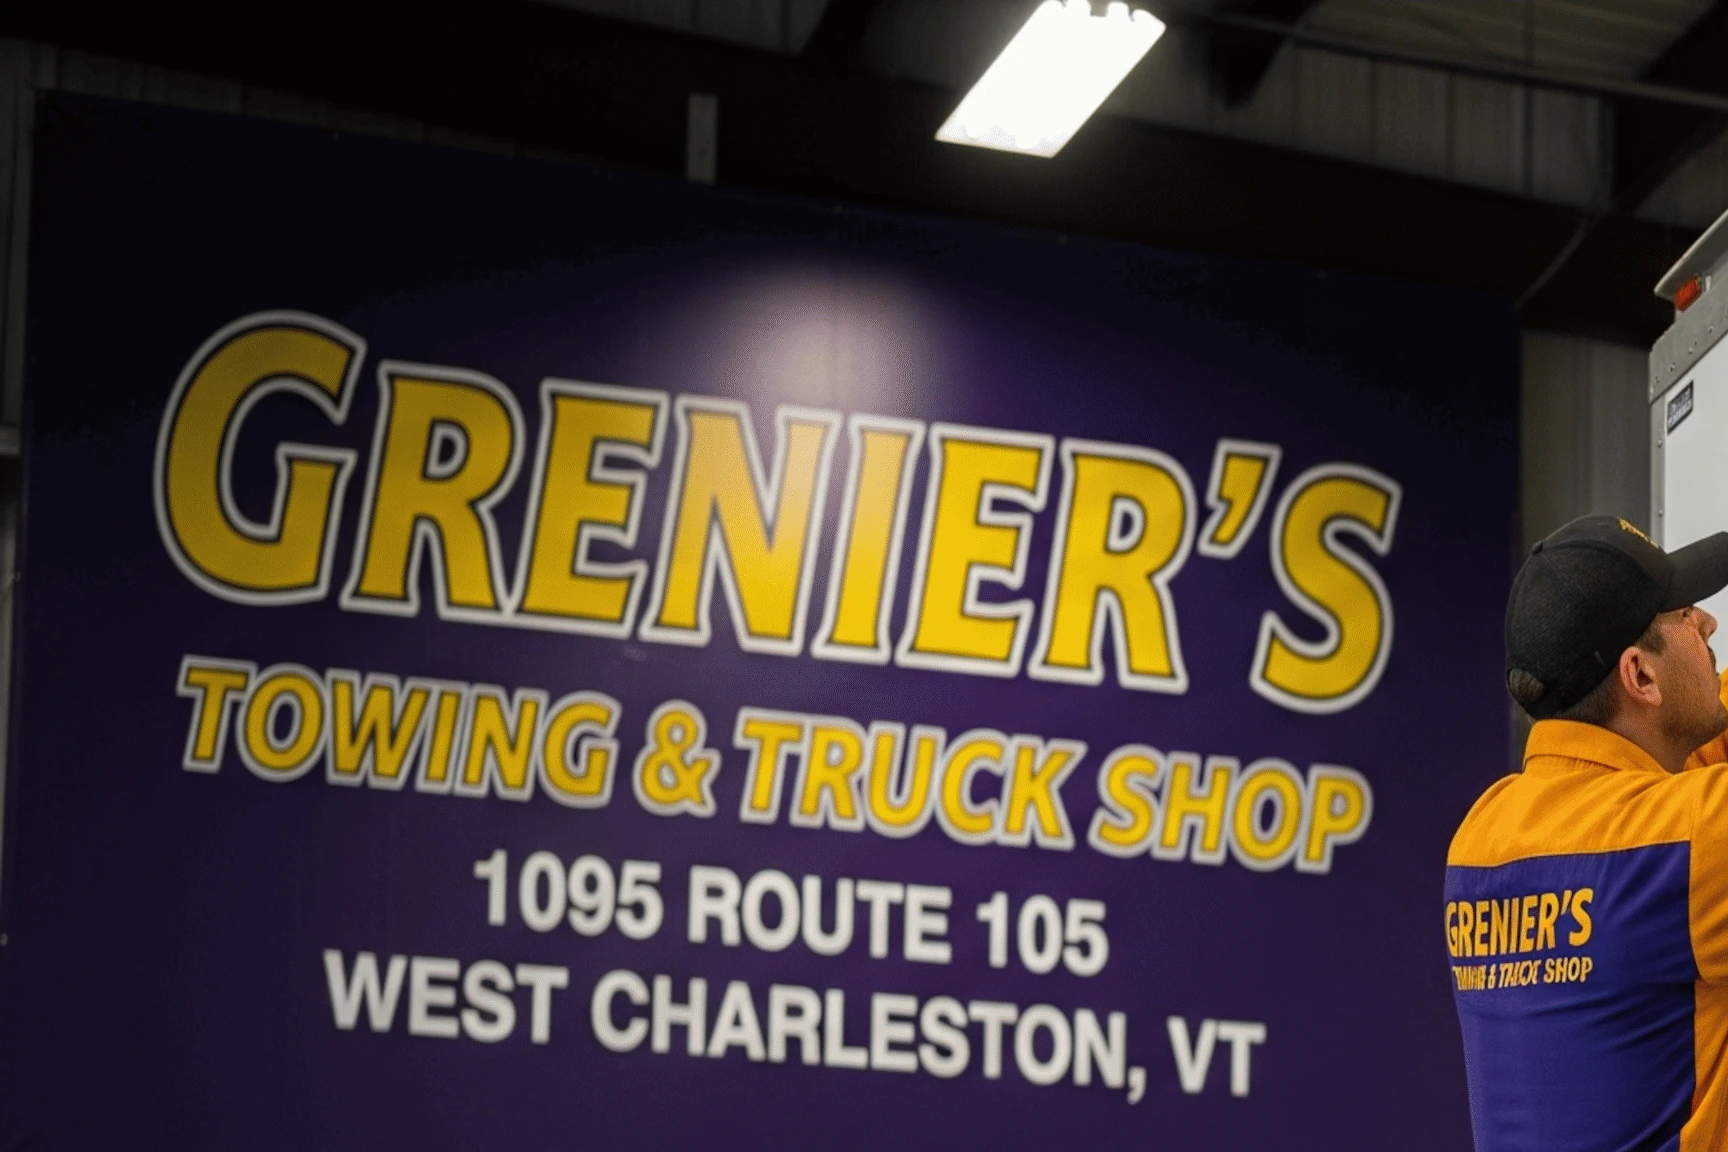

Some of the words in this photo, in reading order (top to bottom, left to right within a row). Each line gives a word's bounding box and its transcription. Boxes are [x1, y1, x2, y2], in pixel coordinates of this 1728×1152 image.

[153, 309, 1402, 714] GRENIER'S
[176, 655, 620, 808] TOWING
[633, 697, 721, 817] &
[735, 707, 1075, 851] TRUCK
[1087, 743, 1373, 874] SHOP
[473, 848, 664, 939] 1095
[687, 865, 952, 964] ROUTE
[976, 891, 1109, 977] 105
[1445, 887, 1594, 958] GRENIER'S
[1543, 956, 1594, 984] SHOP
[323, 948, 569, 1044] WEST
[590, 970, 1147, 1104] CHARLESTON,
[1167, 1016, 1266, 1097] VT
